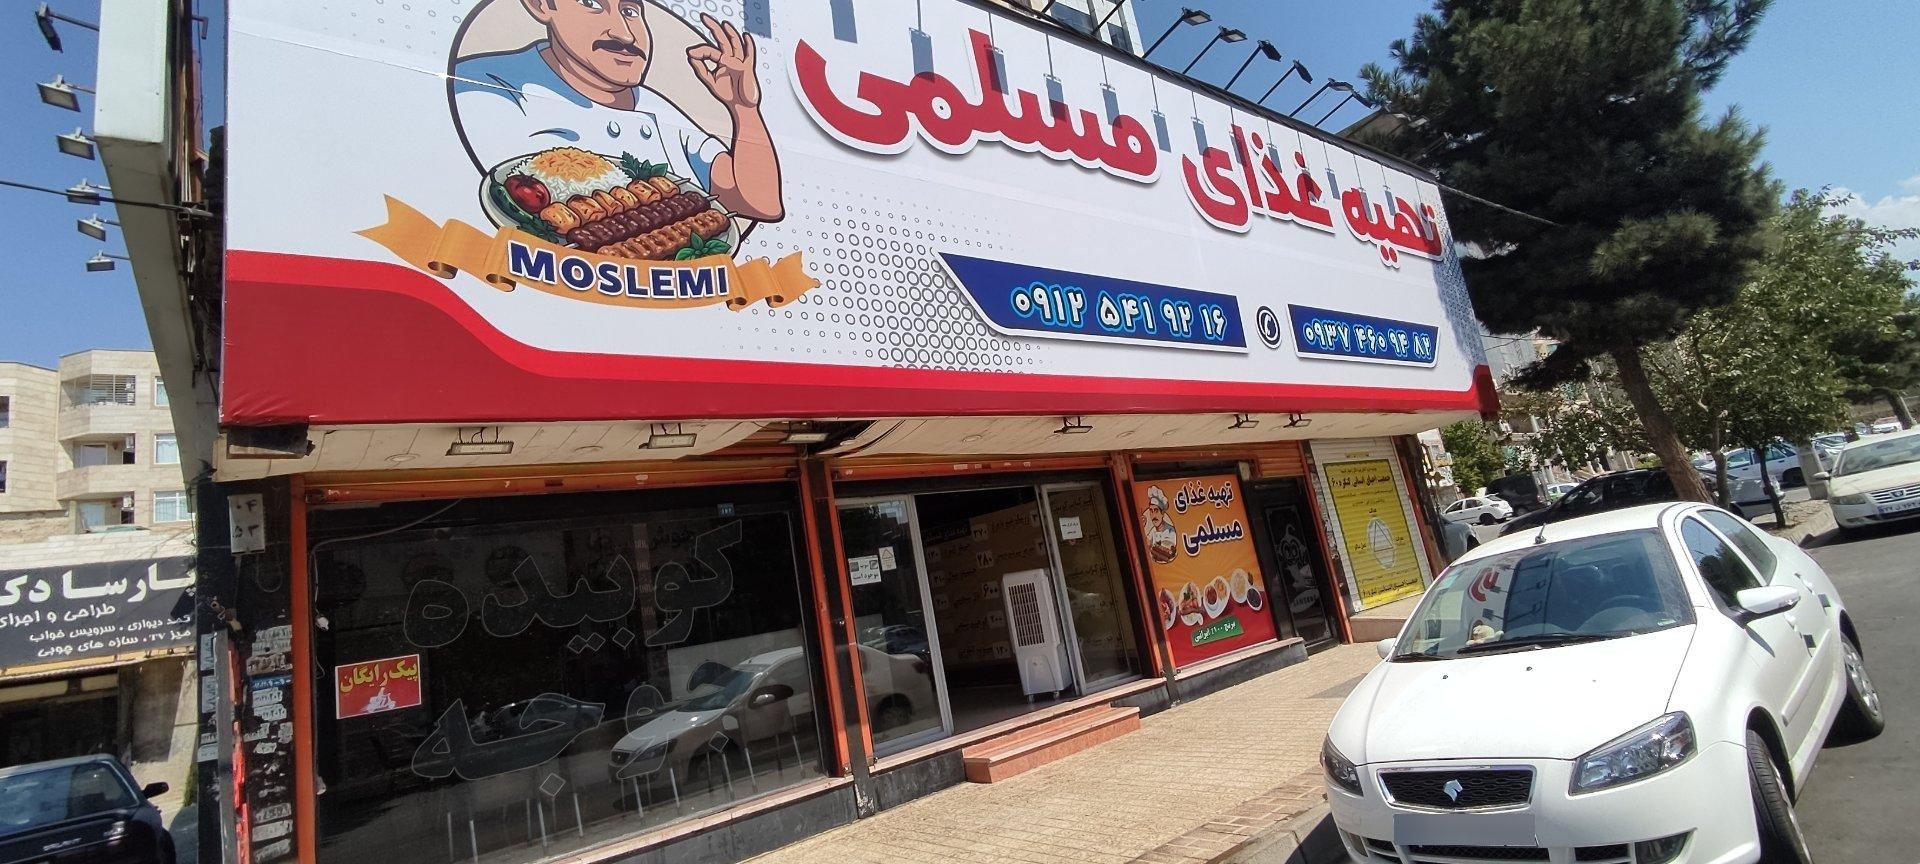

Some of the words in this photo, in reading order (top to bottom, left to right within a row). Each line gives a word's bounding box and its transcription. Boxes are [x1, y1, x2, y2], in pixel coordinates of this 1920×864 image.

[794, 27, 1160, 183] مسلمی
[1181, 122, 1336, 232] غذای
[1342, 184, 1444, 268] تهیه
[508, 240, 729, 298] MOSLEMI
[1013, 284, 1085, 326] ۰۹۱۲
[1100, 293, 1156, 332] ۵۴۱
[1162, 302, 1193, 336] ۹۲
[1201, 306, 1227, 338] ۱۶
[1304, 320, 1349, 349] ۰۹۳۷
[1355, 325, 1387, 352] ۴۶۰
[1389, 330, 1408, 355] ۹۴
[1174, 481, 1207, 513] غذای
[1207, 482, 1234, 509] تهیه
[1182, 514, 1243, 556] مسلمی
[0, 575, 51, 606] دک
[62, 562, 197, 603] پارسا
[404, 519, 742, 654] کوبیده
[46, 611, 57, 624] و
[64, 603, 116, 622] طراحی
[128, 619, 163, 632] دیواری
[29, 628, 66, 643] خواب
[70, 624, 116, 638] سرویس
[109, 635, 139, 648] سازه
[149, 632, 166, 642] TV
[169, 628, 191, 641] میز
[37, 643, 73, 658] چوبی
[77, 640, 104, 653] های
[340, 664, 388, 692] رایگان
[389, 660, 417, 681] پیک
